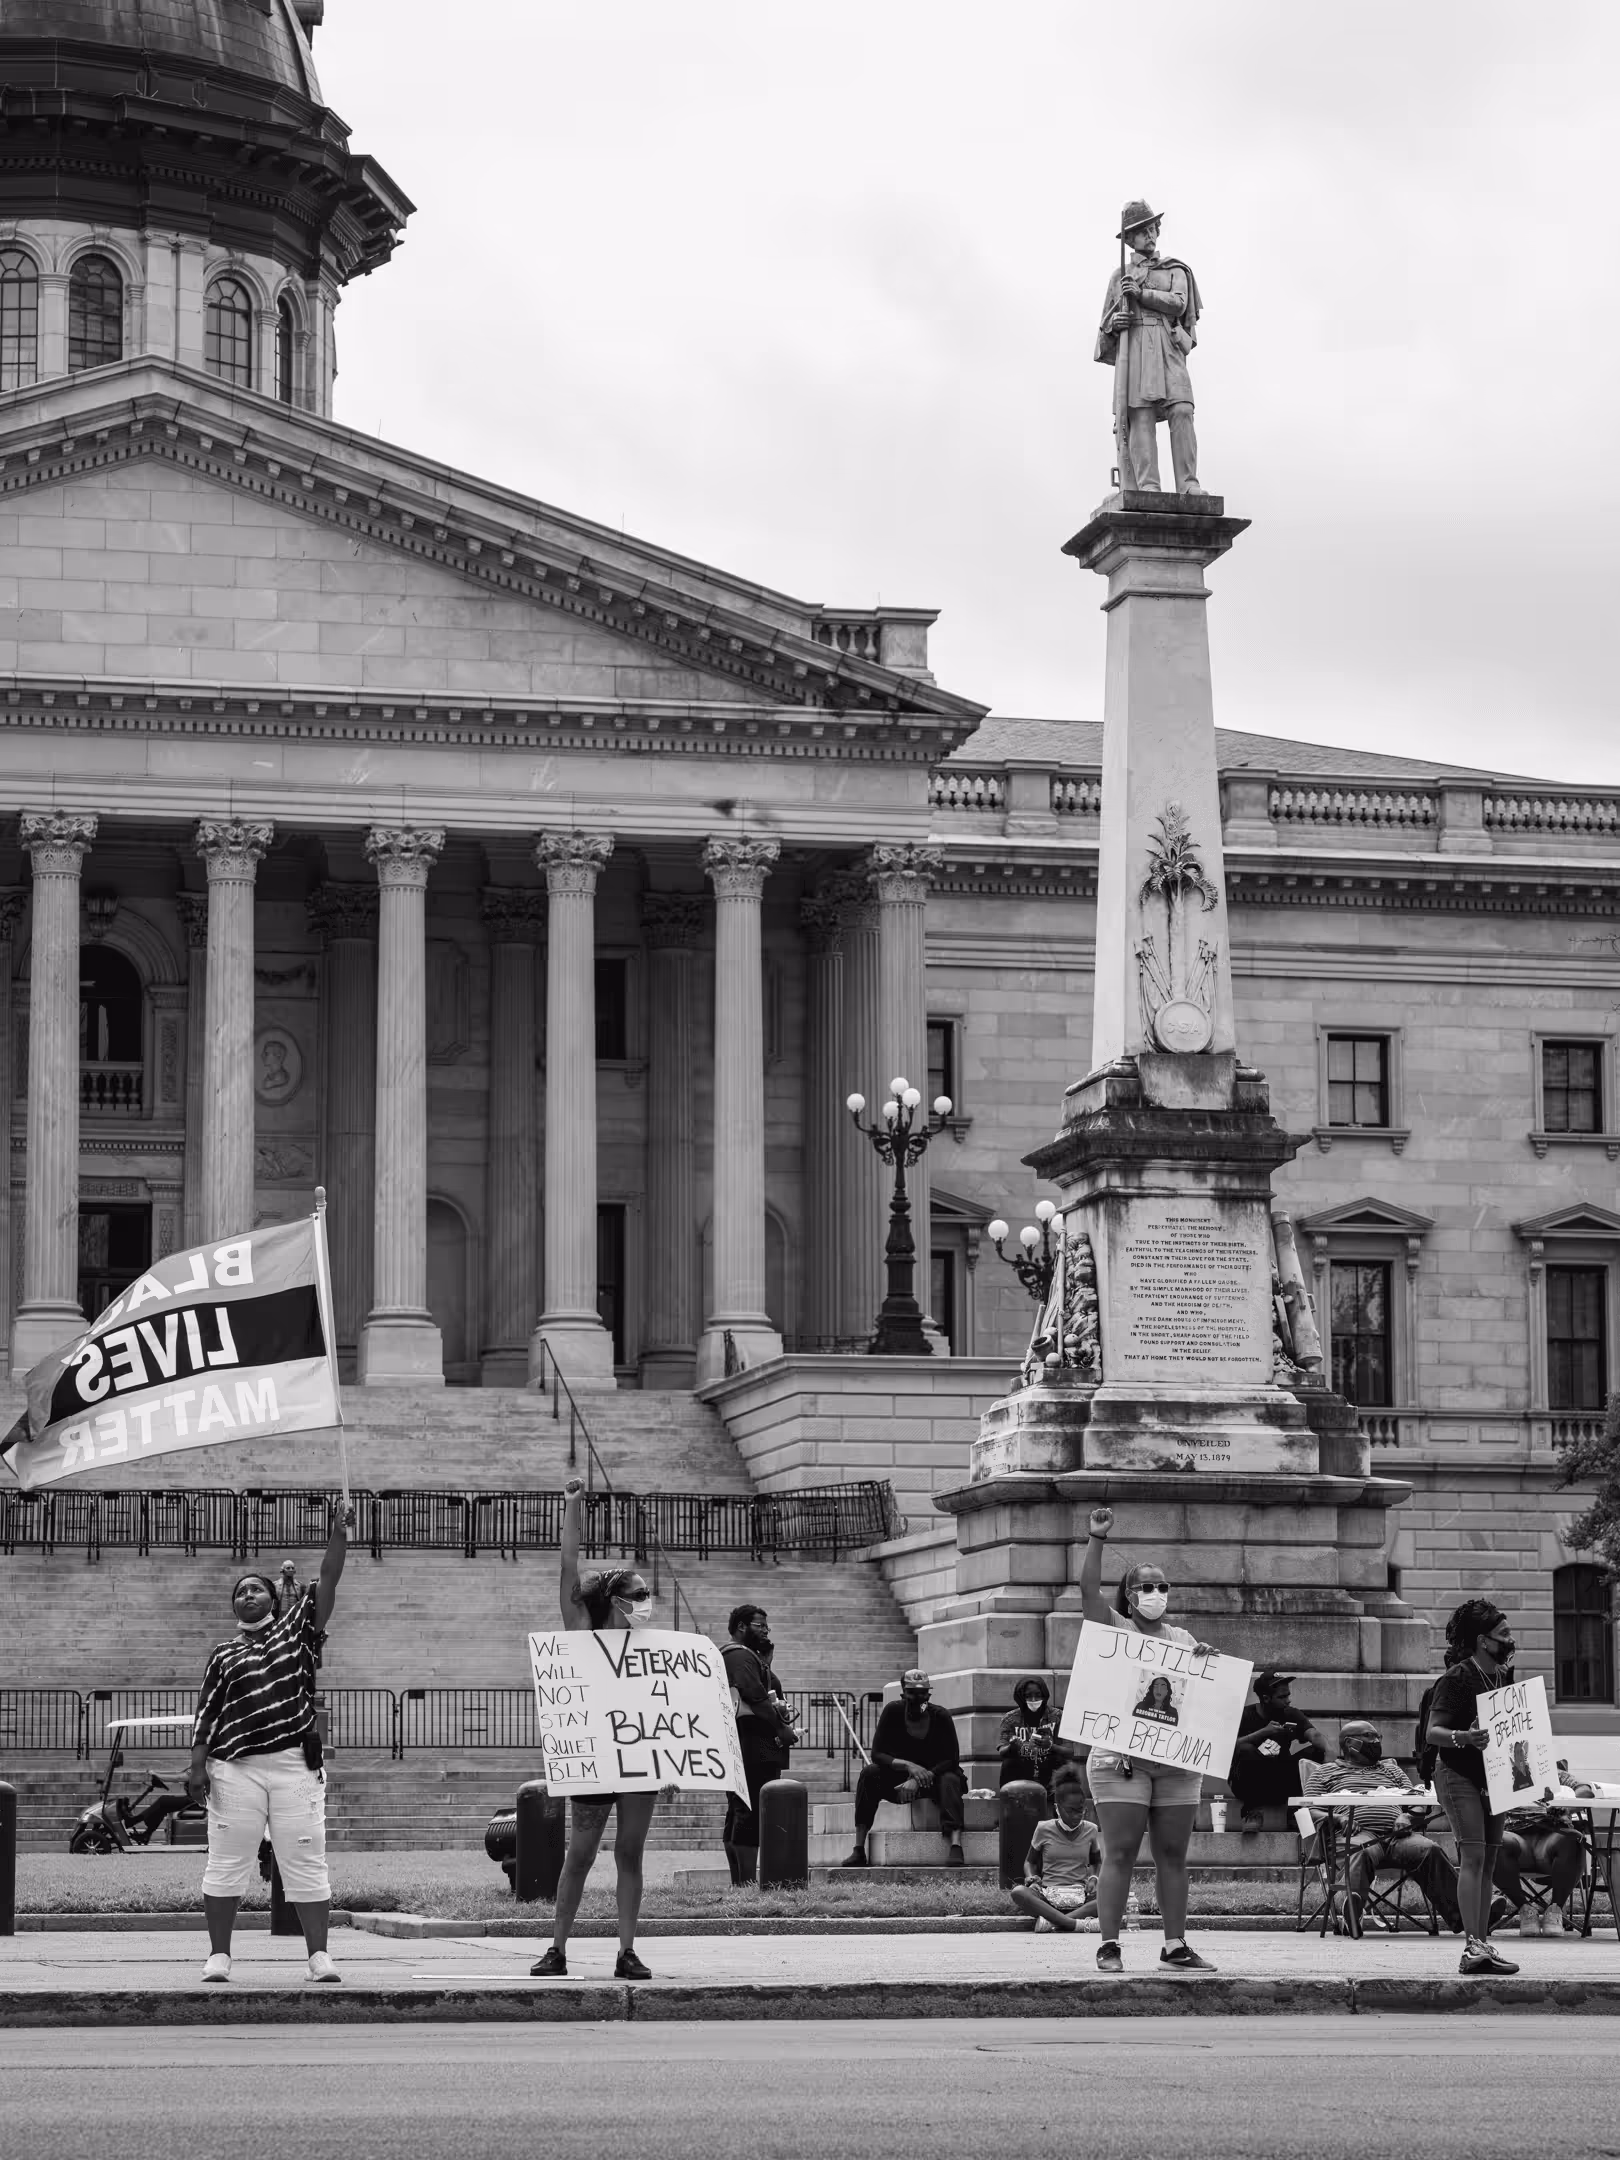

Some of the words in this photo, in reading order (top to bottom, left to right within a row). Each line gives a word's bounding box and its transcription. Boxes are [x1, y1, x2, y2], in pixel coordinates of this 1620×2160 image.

[1177, 1440, 1231, 1448] UNVEILED
[1176, 1453, 1198, 1461] MAY
[1212, 1454, 1231, 1462] 1879
[532, 1636, 570, 1656] WE
[592, 1631, 712, 1679] VETERANS
[1099, 1630, 1220, 1681] JUSTICE
[535, 1664, 583, 1680] WILL
[537, 1685, 590, 1707] NOT
[651, 1680, 669, 1706] 4
[1488, 1691, 1501, 1721] I
[541, 1710, 589, 1729] STAY
[605, 1710, 709, 1745] BLACK
[1495, 1711, 1533, 1747] BREATHE
[542, 1734, 597, 1755] QUIET
[1080, 1711, 1120, 1742] FOR
[1128, 1721, 1212, 1770] BREONNA
[547, 1761, 598, 1782] BLM
[617, 1748, 726, 1779] LIVES
